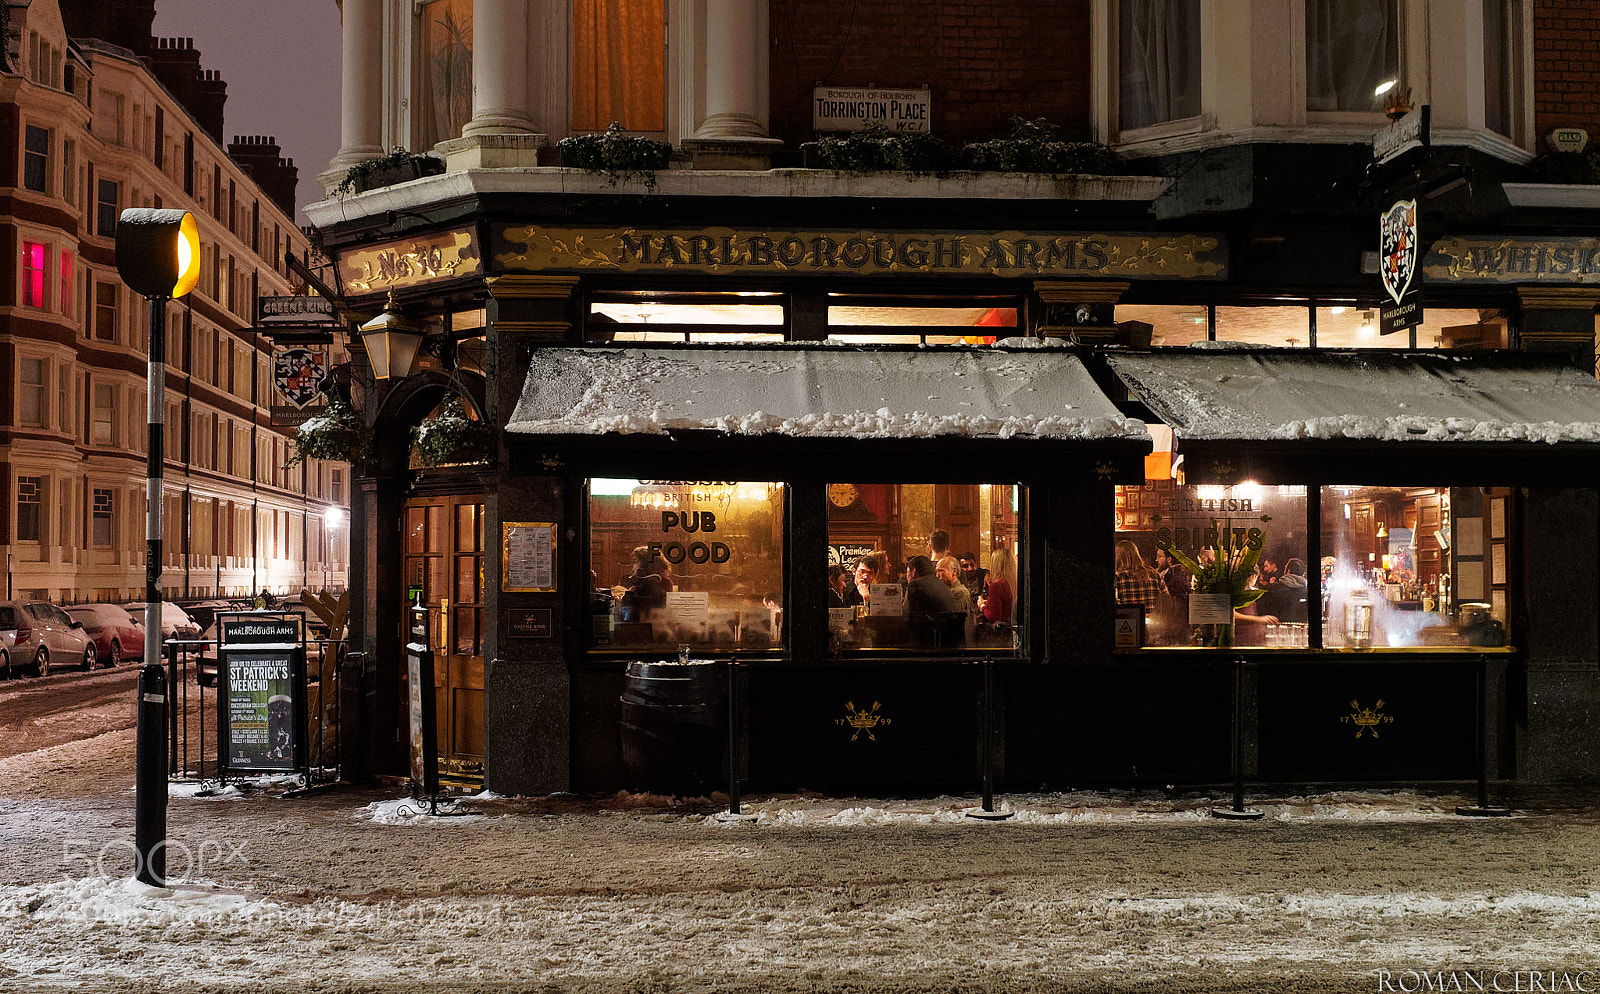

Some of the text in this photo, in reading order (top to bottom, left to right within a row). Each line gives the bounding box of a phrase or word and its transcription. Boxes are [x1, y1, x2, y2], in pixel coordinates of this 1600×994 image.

[827, 90, 916, 101] BOROUGH OF HOLBORN
[816, 98, 927, 121] TORRINGTON PLACE
[618, 234, 1109, 270] MARLBOROUGH ARMS
[263, 300, 333, 314] GREENE KING
[1383, 302, 1416, 320] MARLBOROUGH
[1393, 317, 1406, 327] ARMS
[664, 493, 712, 502] BRITISH
[1167, 498, 1253, 512] BRITISH
[661, 510, 717, 533] PUB
[1156, 527, 1264, 551] SPIRITS
[647, 541, 731, 564] FOOD
[839, 545, 872, 556] Premier
[228, 625, 294, 636] MARLBOROUGH ARMS
[230, 666, 288, 680] ST PATRICK'S
[230, 679, 269, 692] WEEKEND
[835, 718, 892, 726] 17 99
[1340, 716, 1394, 724] 17 99
